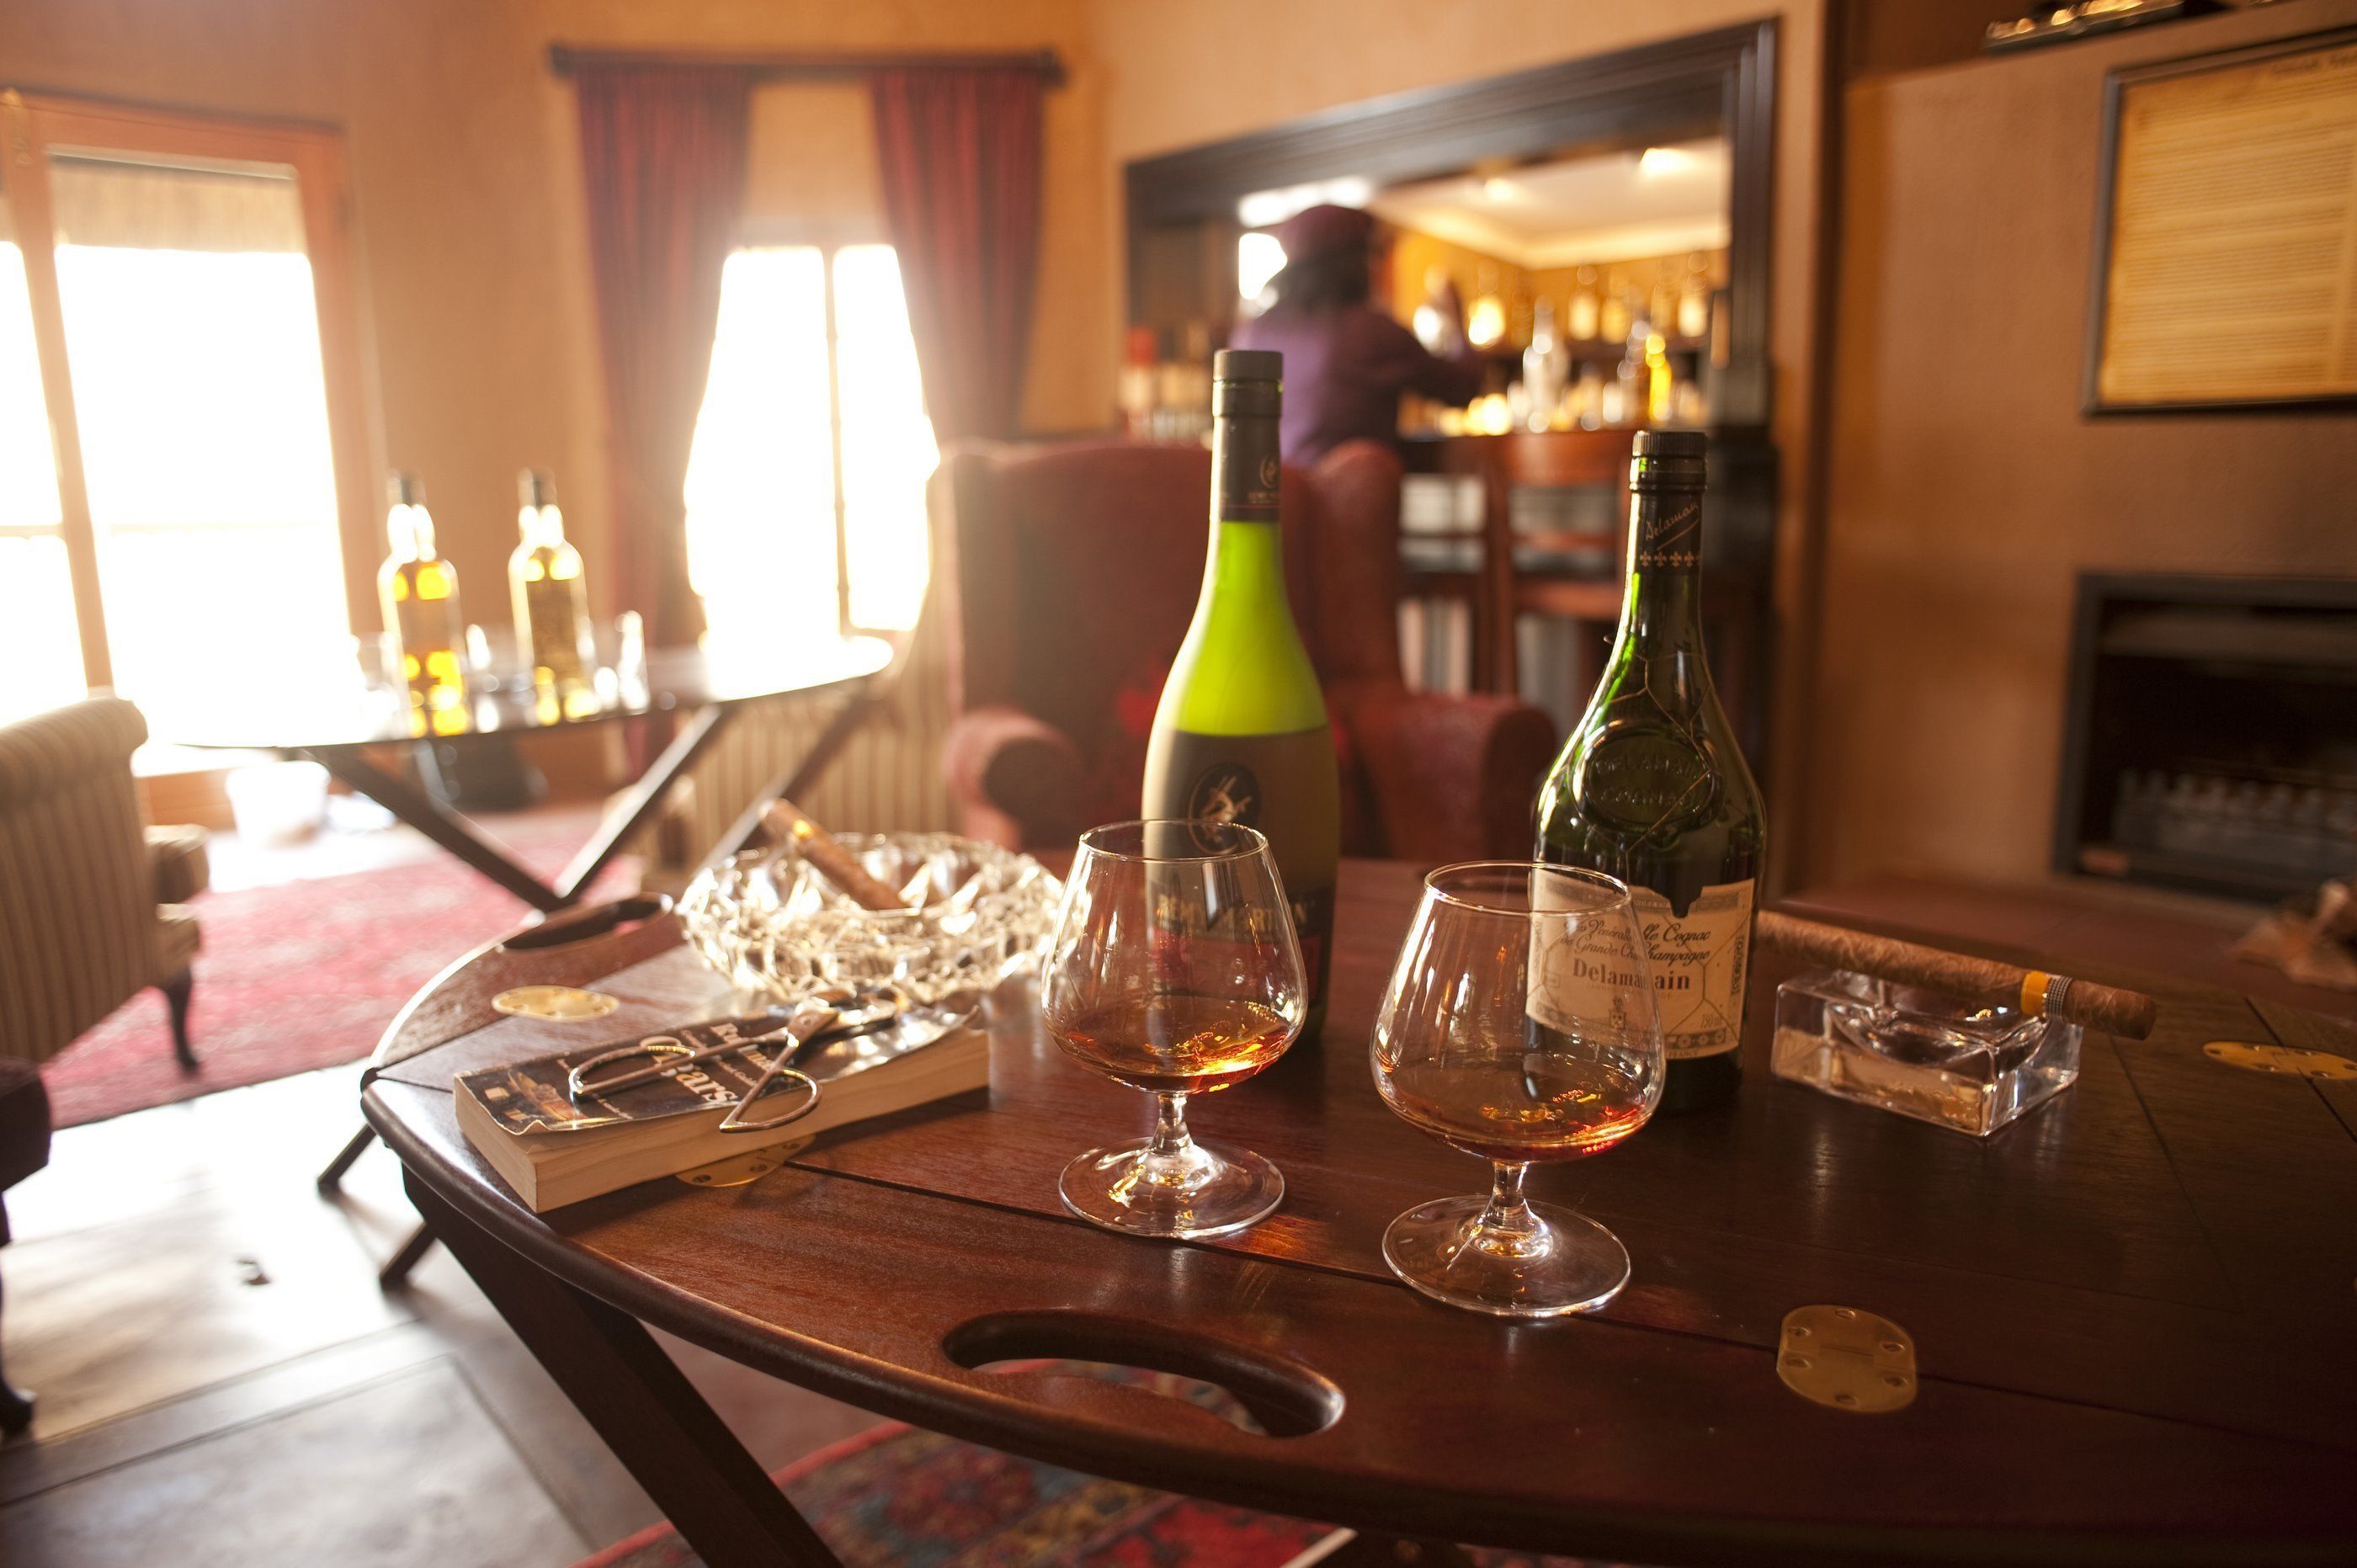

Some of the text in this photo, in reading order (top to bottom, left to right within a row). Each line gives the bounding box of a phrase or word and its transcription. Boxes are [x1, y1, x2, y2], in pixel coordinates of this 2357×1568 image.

[1575, 933, 1618, 955] Grande
[1663, 923, 1711, 947] Cognac
[1573, 958, 1689, 990] Delamain
